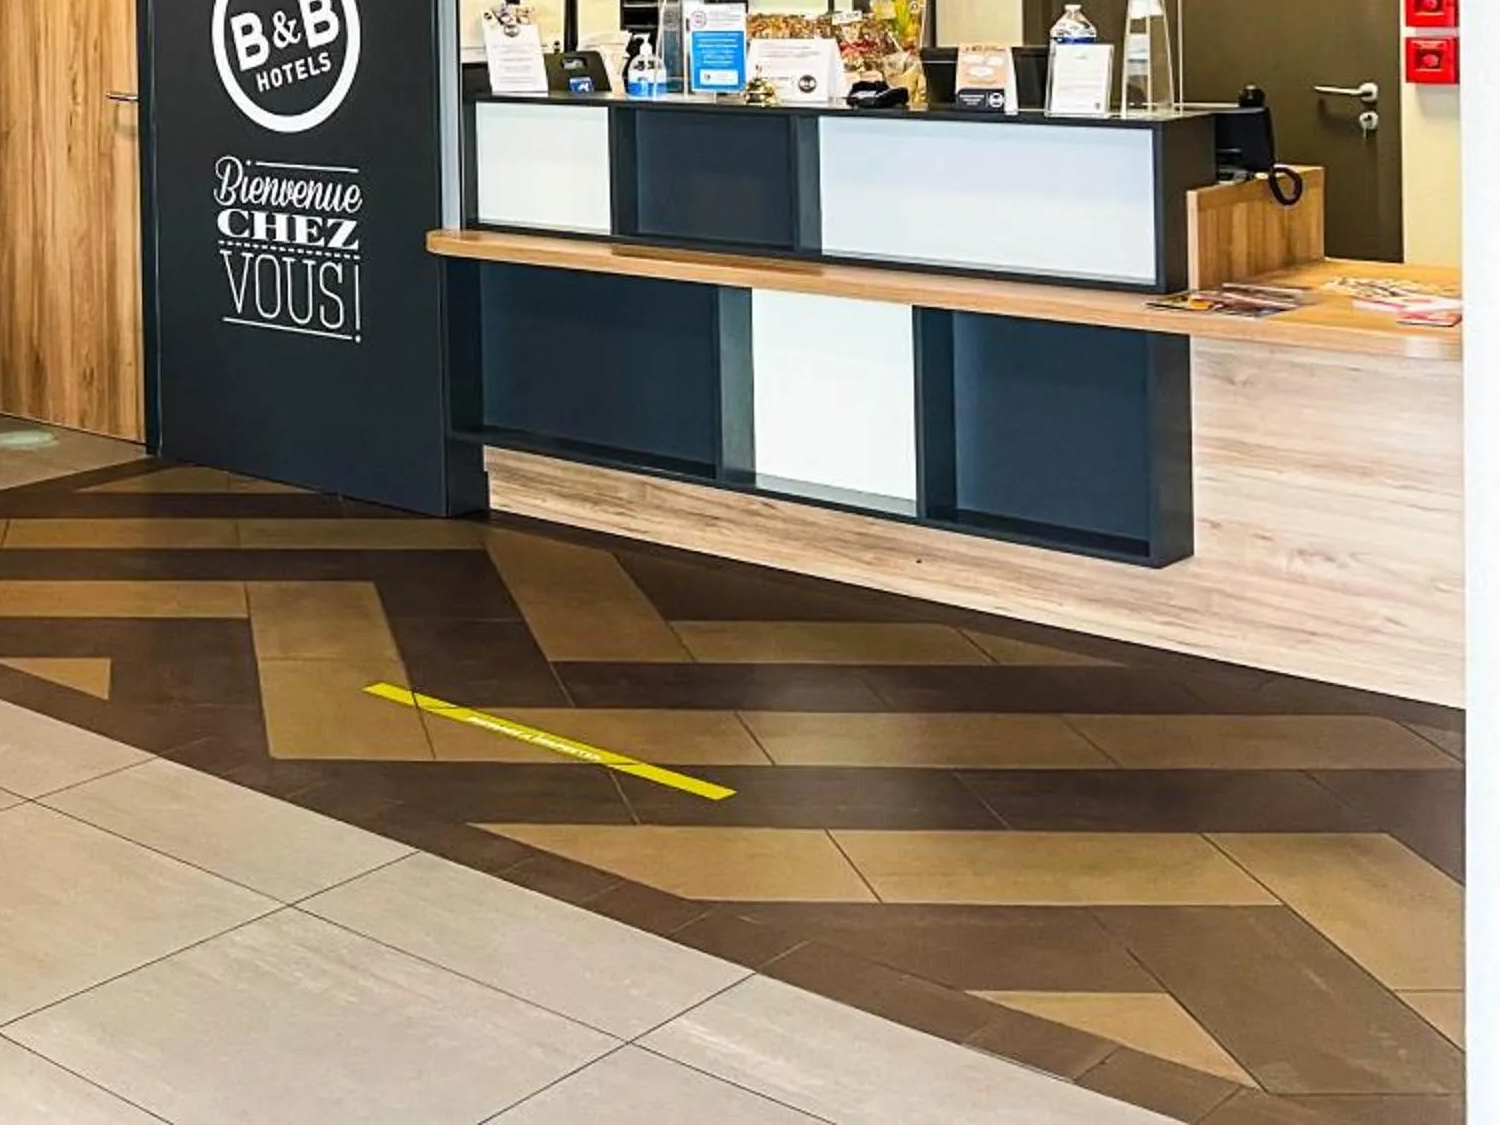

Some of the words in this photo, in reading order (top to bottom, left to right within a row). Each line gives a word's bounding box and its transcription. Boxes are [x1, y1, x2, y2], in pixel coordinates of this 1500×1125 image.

[256, 52, 332, 92] HOTELS
[213, 155, 363, 214] Bienvenue
[217, 208, 359, 250] CHEZ
[219, 248, 362, 344] VOUS!
